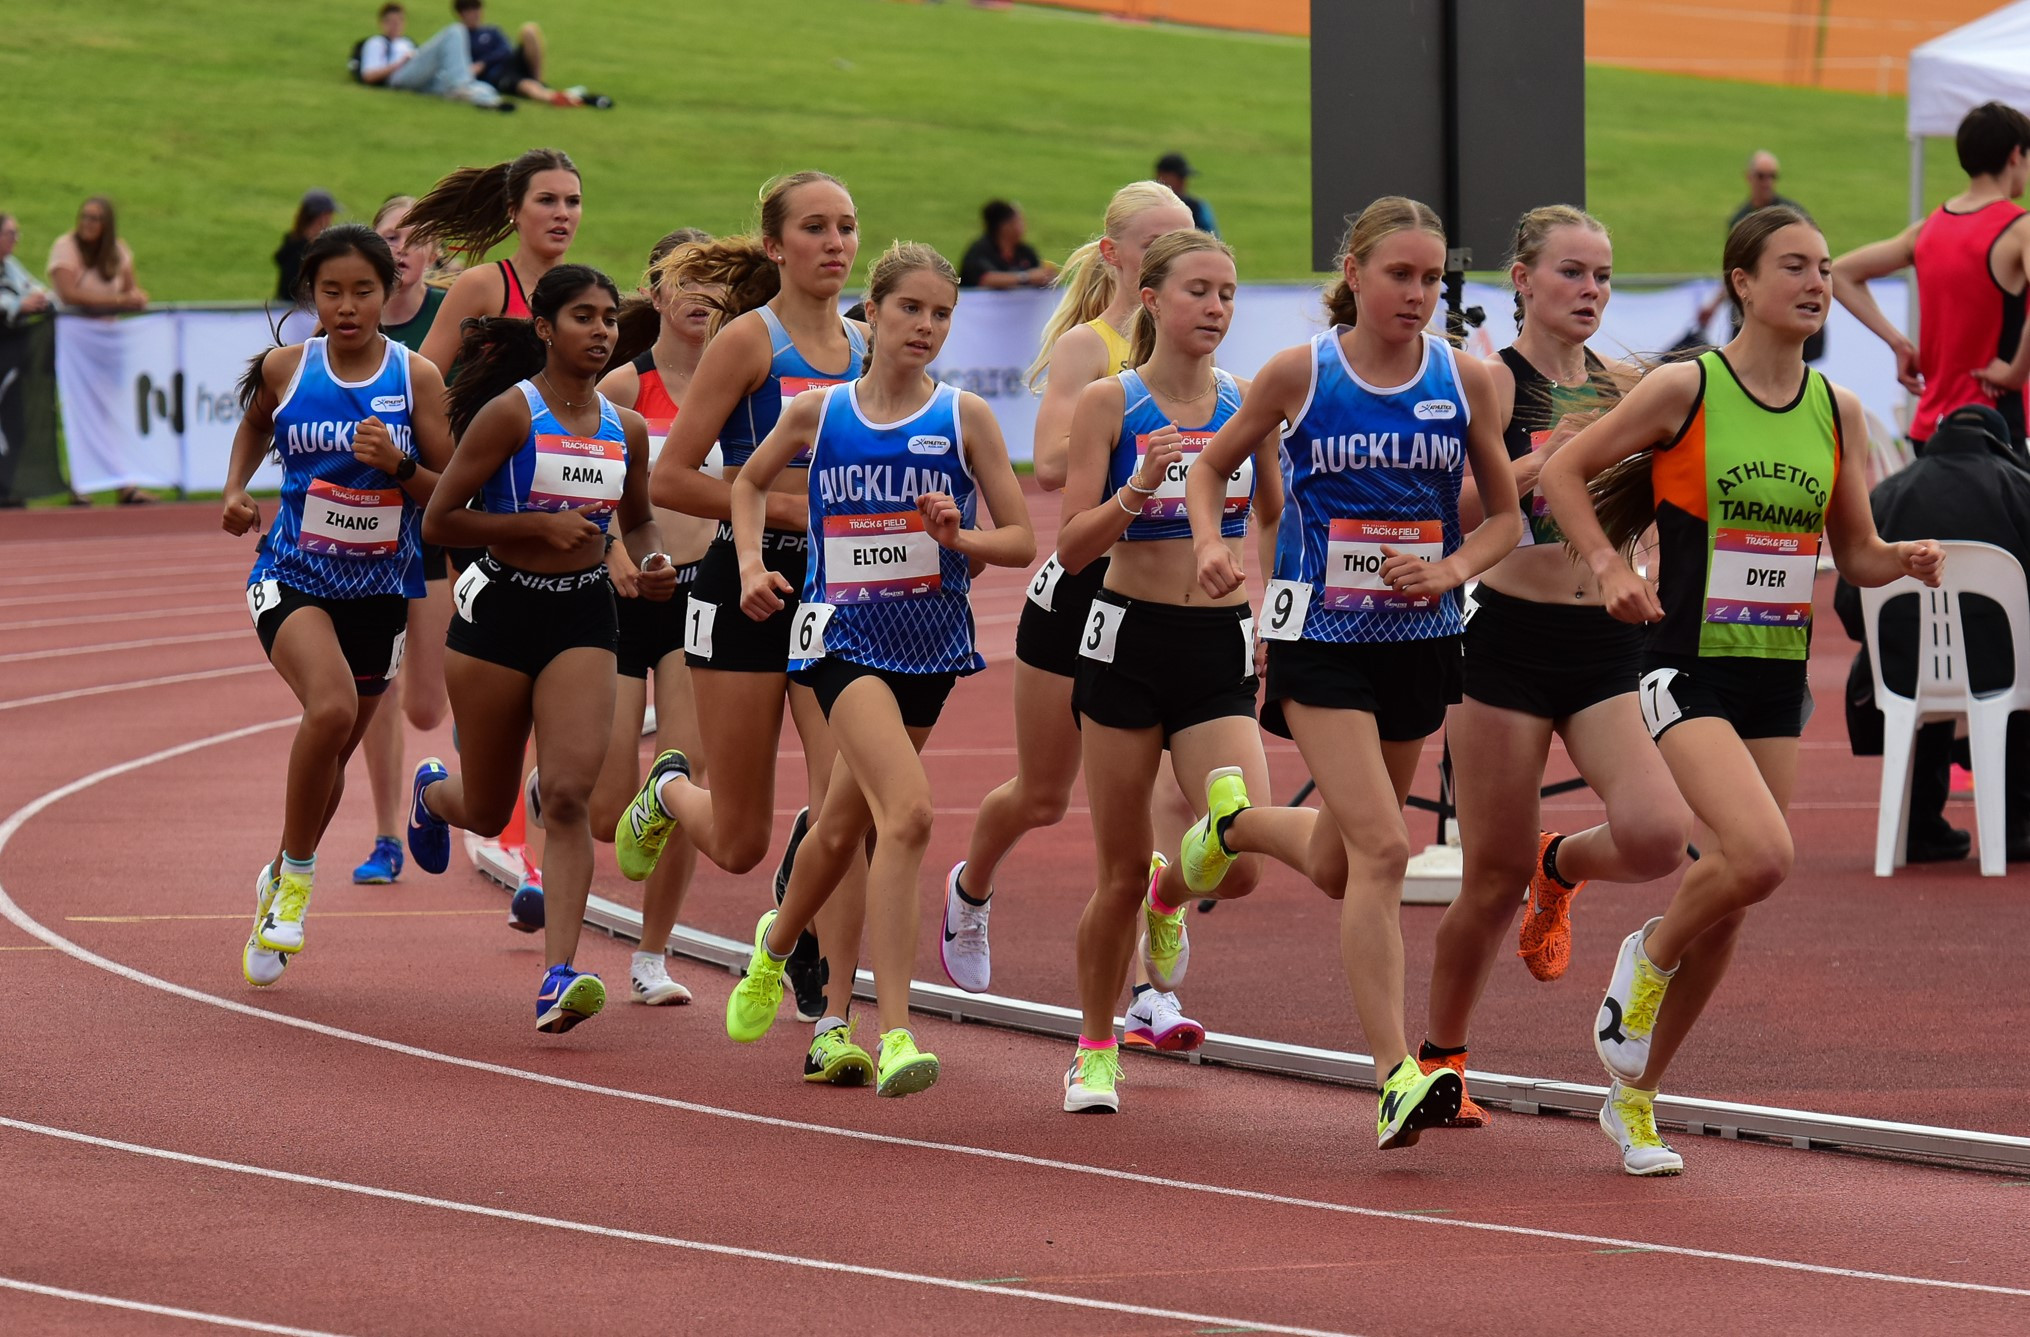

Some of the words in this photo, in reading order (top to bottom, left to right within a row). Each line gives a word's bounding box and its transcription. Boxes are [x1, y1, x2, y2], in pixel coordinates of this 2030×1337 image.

[288, 421, 412, 456] AUCKND
[1311, 432, 1461, 475] AUCKLAND
[562, 466, 604, 484] RAMA
[820, 464, 953, 508] AUCKLAND
[1717, 461, 1826, 508] ATHLETICS
[326, 511, 379, 530] ZHANG
[1719, 500, 1822, 529] TARANAKI
[853, 545, 907, 566] ELTON
[459, 576, 476, 609] 4
[510, 571, 575, 592] NIKE
[1034, 560, 1055, 596] 5
[1746, 568, 1787, 588] DYER
[253, 581, 265, 611] 8
[1271, 588, 1293, 629] 9
[692, 609, 700, 647] 1
[800, 611, 817, 651] 6
[1087, 610, 1105, 651] 3
[1647, 677, 1660, 722] 7
